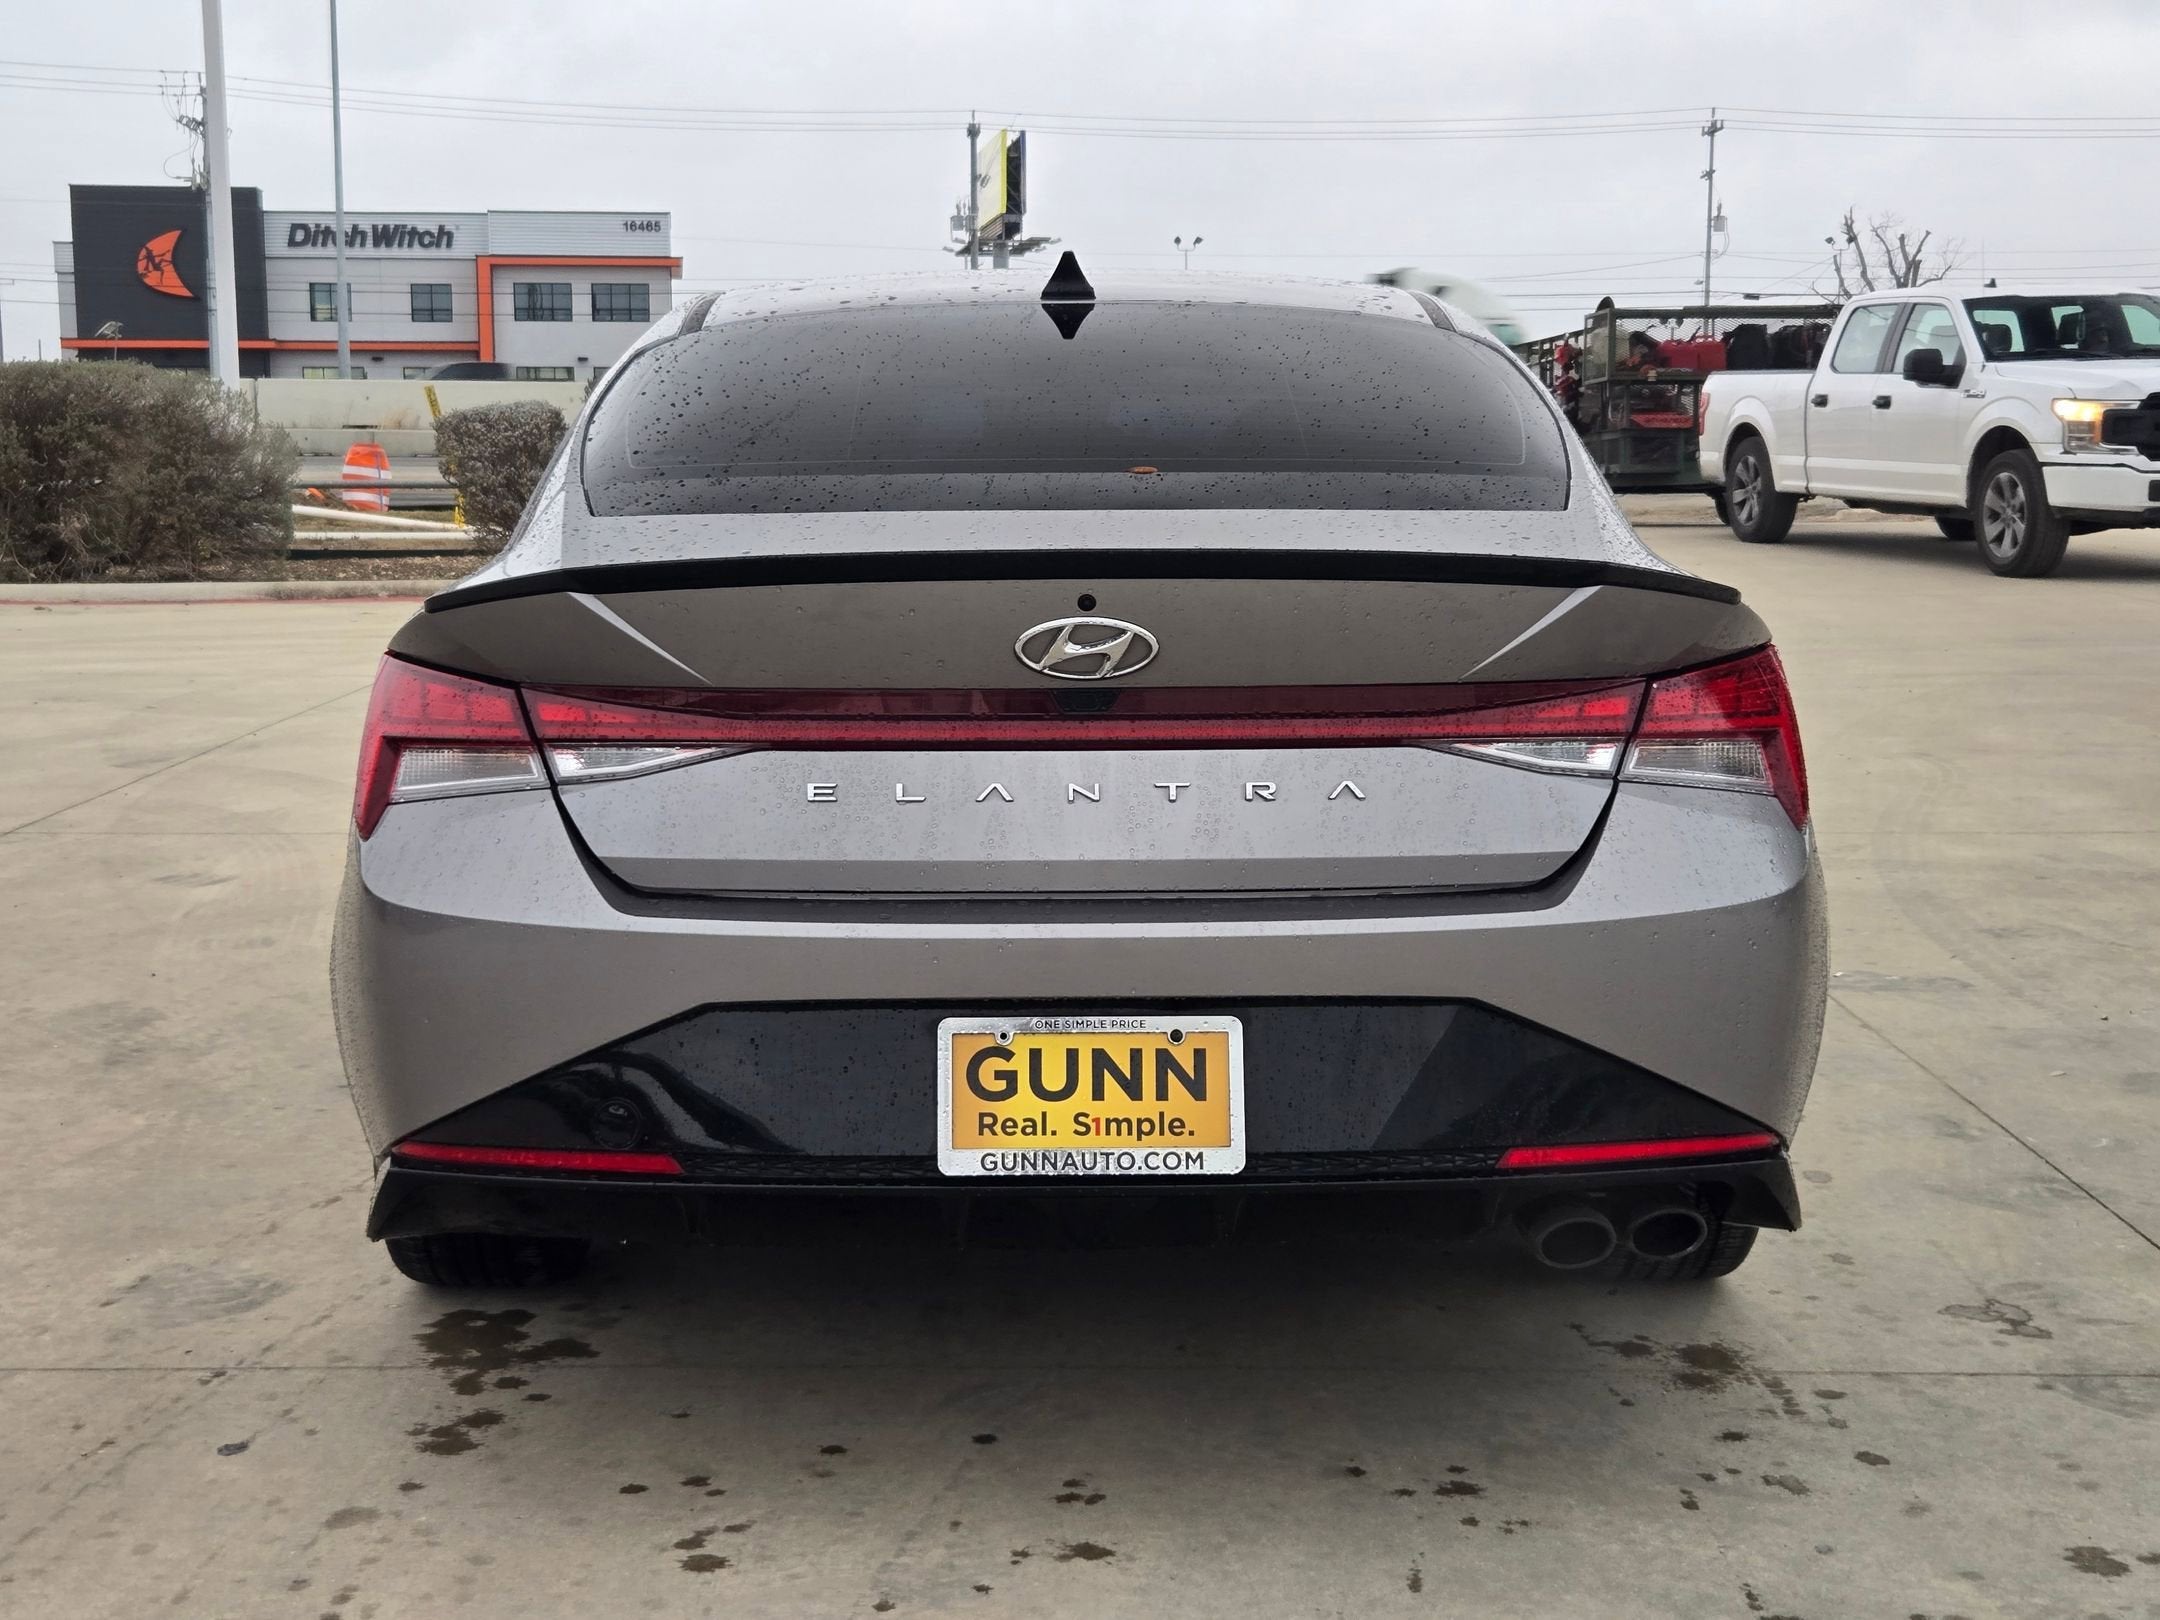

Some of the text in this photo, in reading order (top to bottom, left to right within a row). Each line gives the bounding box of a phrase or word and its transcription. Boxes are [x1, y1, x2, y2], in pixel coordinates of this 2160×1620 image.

[371, 223, 455, 249] Witch
[622, 220, 662, 233] 16465
[806, 781, 1367, 803] ELANTRA
[1034, 1019, 1147, 1030] ONE SIMPLE PRICE
[965, 1045, 1208, 1103] GUNN
[977, 1110, 1058, 1137] Real.
[980, 1150, 1205, 1172] GUNNAUTO.COM
